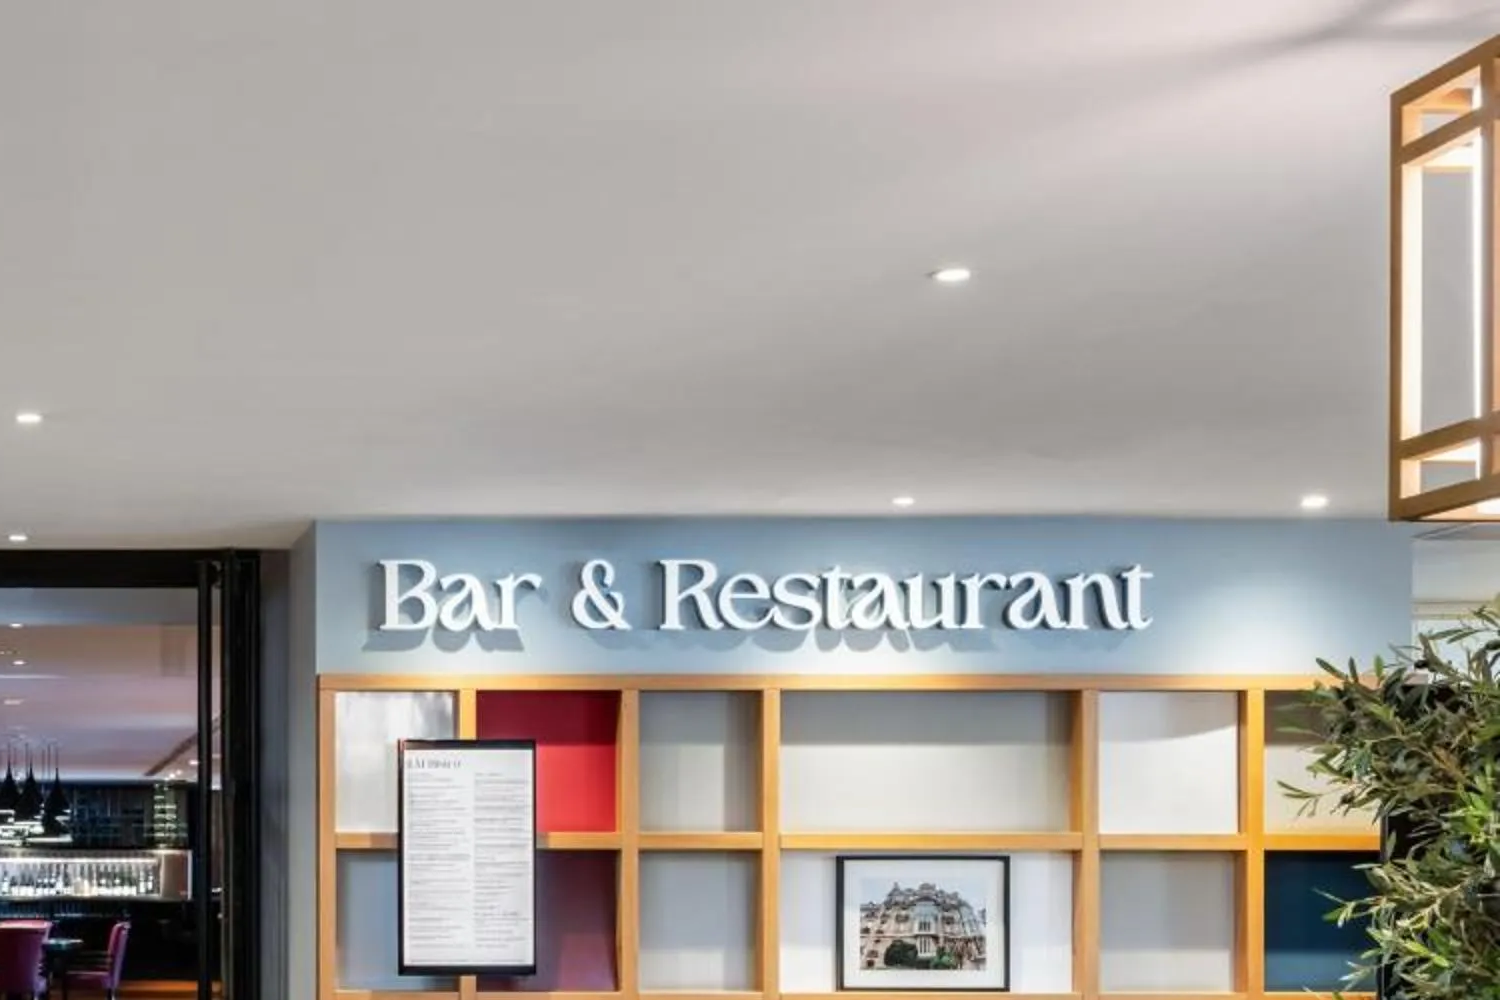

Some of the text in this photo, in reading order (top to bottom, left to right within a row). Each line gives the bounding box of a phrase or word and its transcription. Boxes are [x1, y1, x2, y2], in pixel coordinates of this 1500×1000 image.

[379, 558, 1155, 632] Bar & Restaurant
